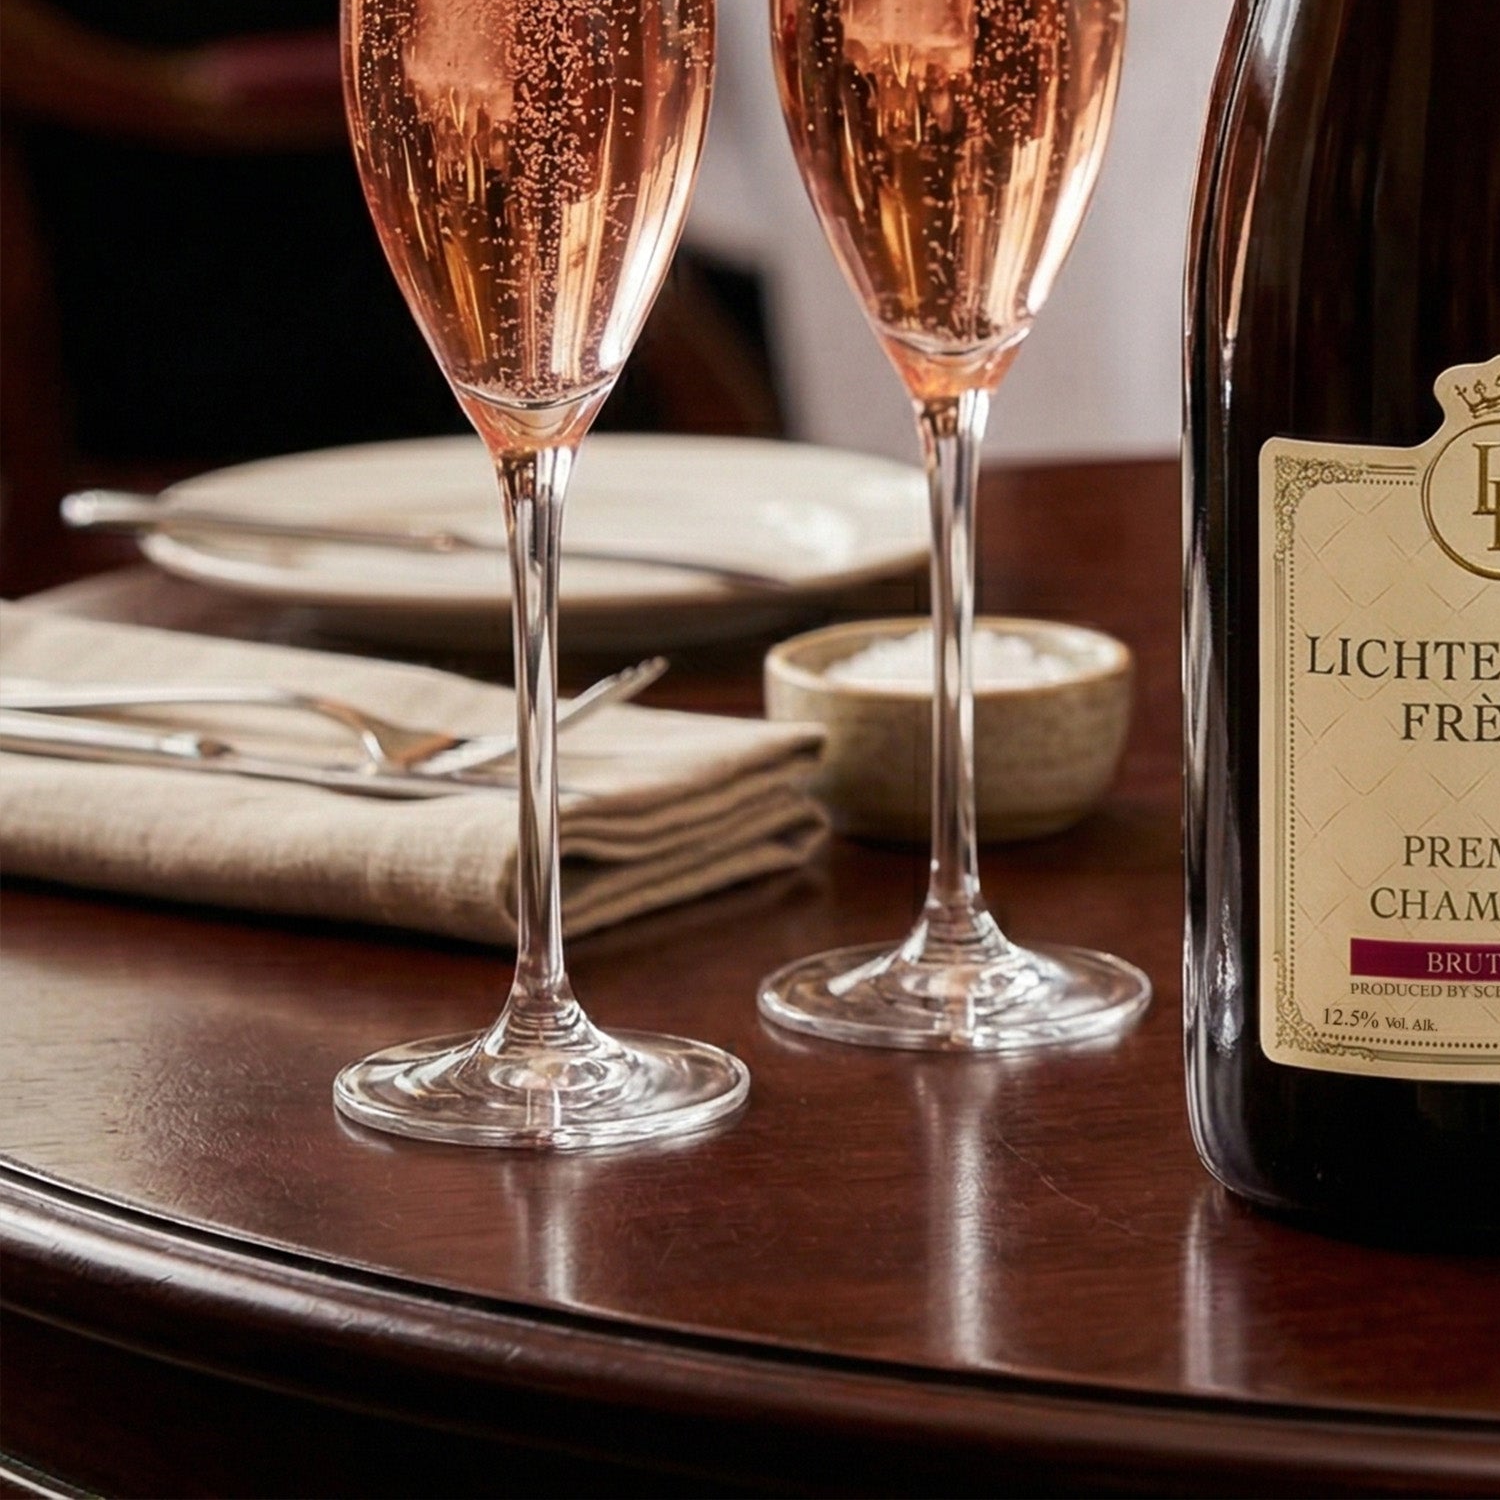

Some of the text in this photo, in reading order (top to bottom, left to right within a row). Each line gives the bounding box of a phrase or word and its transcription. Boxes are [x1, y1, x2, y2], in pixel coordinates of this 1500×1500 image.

[1350, 982, 1443, 997] PRODUCED
[1447, 985, 1470, 998] BY
[1322, 1007, 1438, 1032] 12.5% Vol. Alk.
